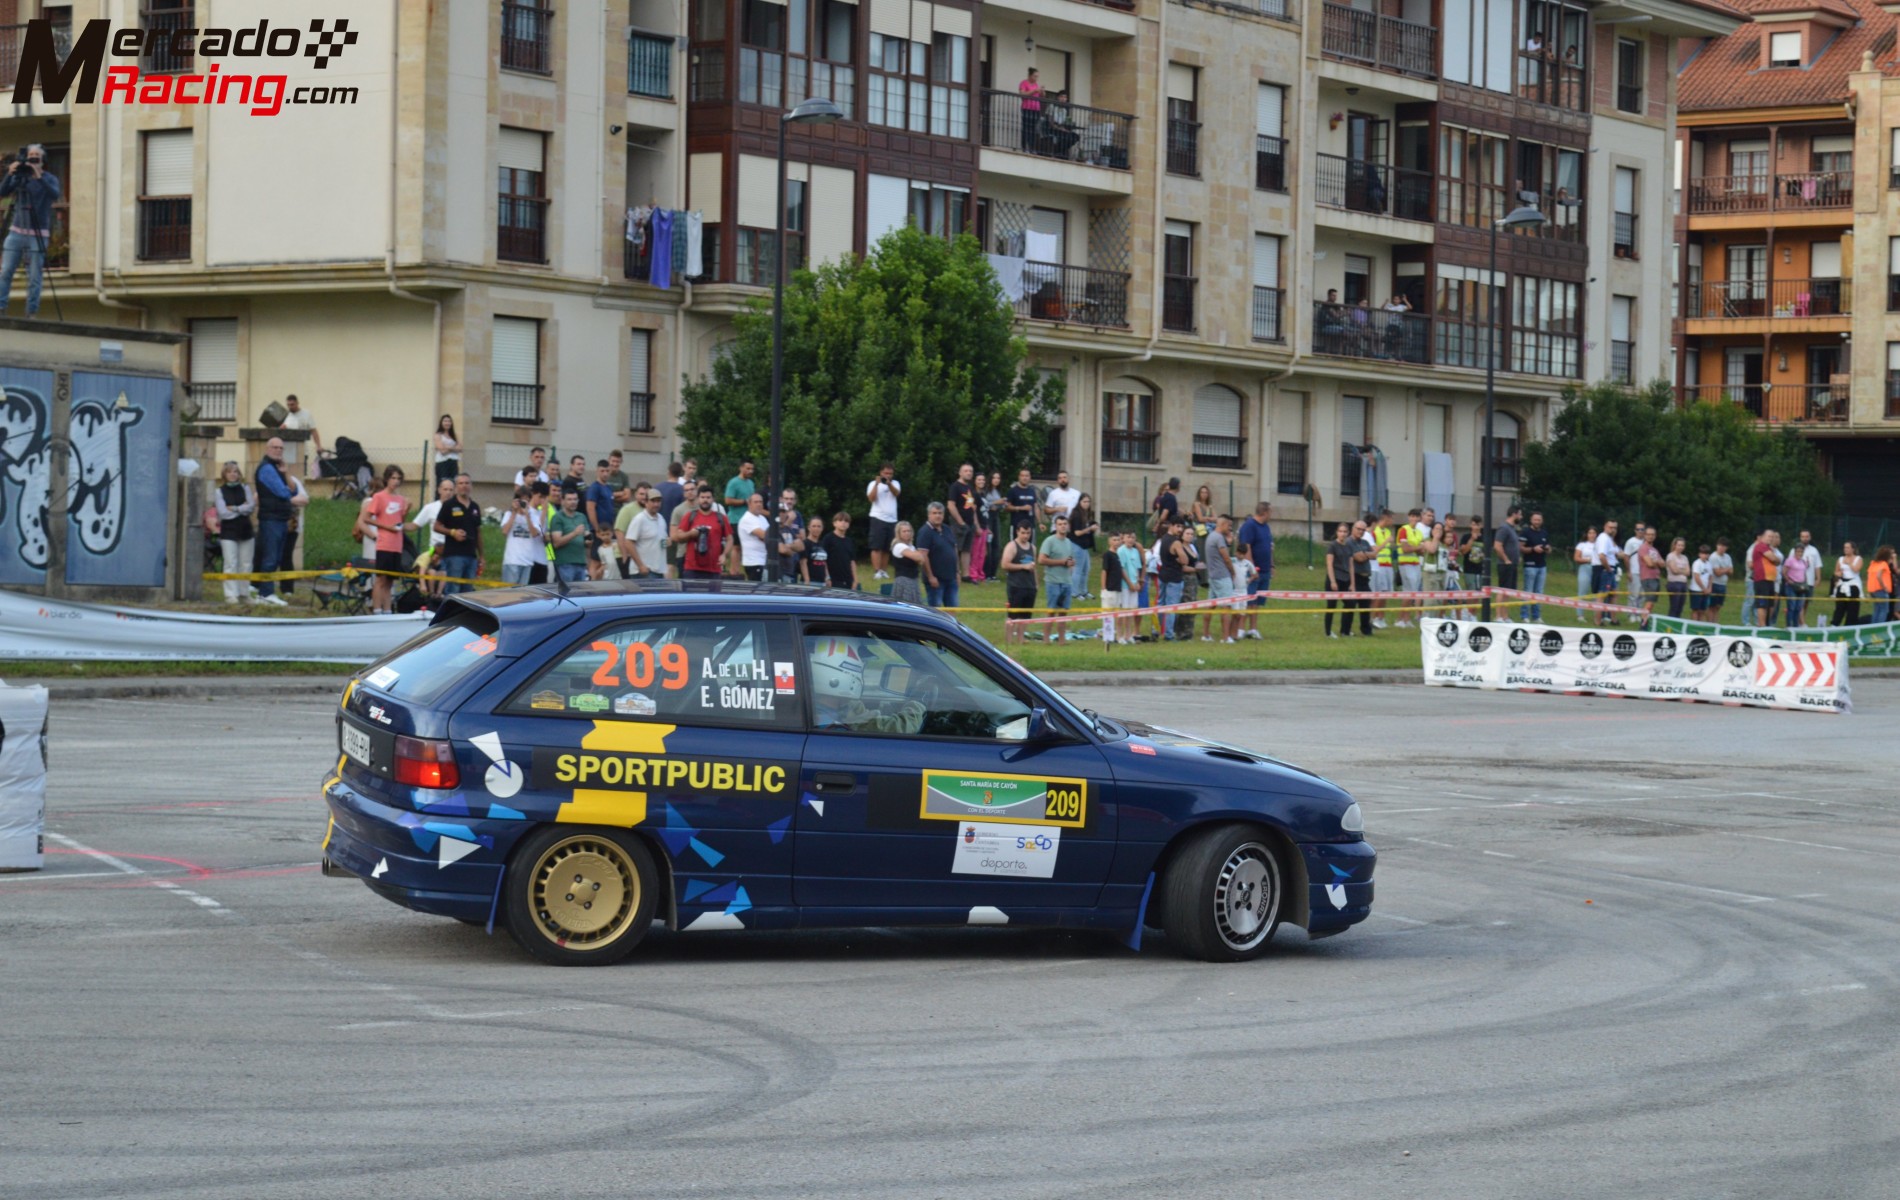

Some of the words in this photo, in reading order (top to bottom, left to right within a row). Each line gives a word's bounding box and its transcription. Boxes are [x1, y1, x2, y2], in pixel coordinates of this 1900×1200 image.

[591, 640, 688, 690] 209
[702, 658, 717, 679] A.
[719, 664, 730, 677] DE
[735, 664, 748, 678] LA
[752, 659, 769, 681] H.
[701, 686, 714, 708] E.
[720, 684, 775, 710] GÓMEZ
[555, 754, 786, 793] SPORTPUBLIC
[1045, 789, 1079, 818] 209
